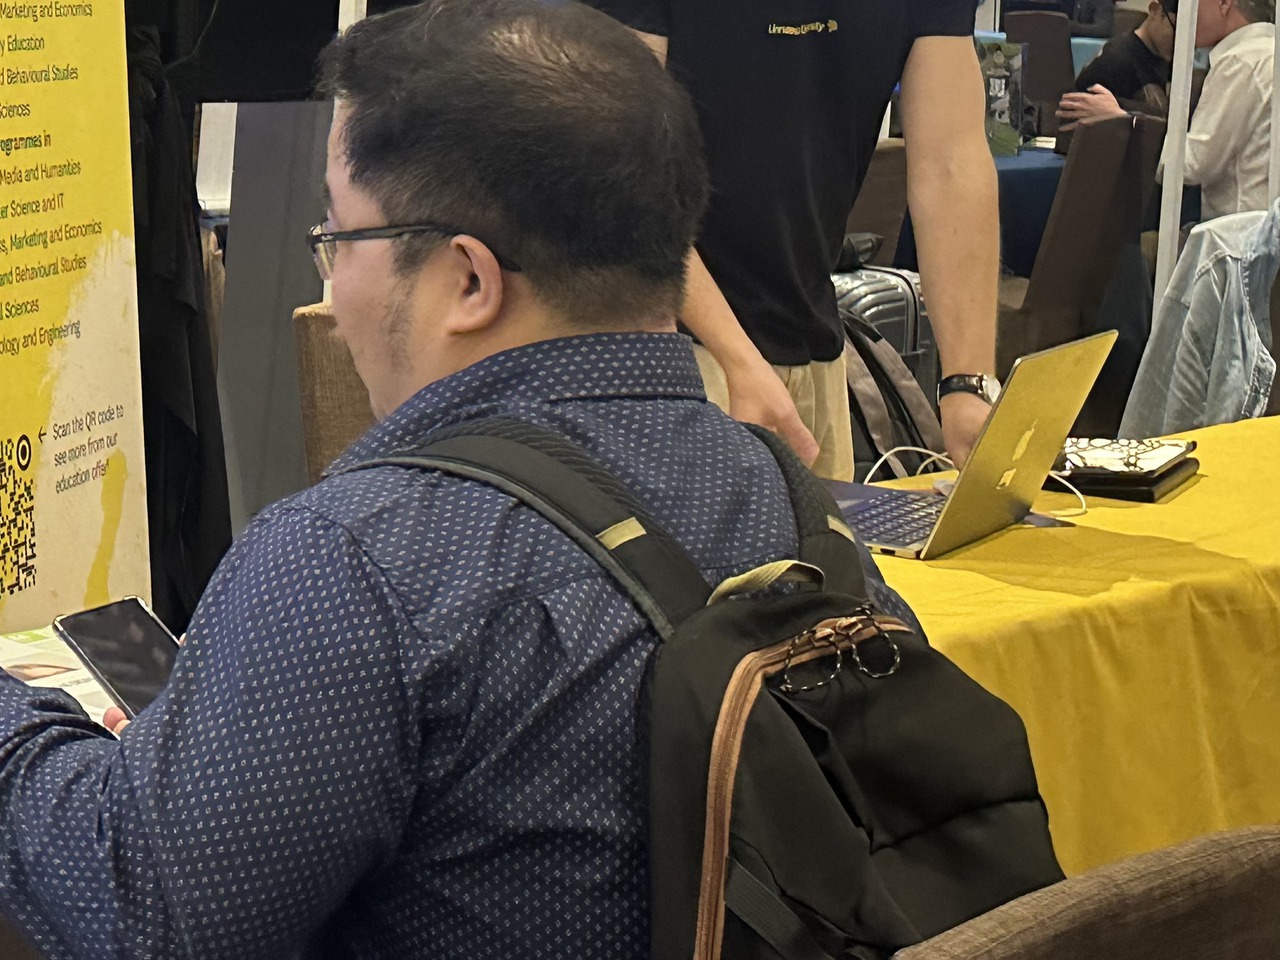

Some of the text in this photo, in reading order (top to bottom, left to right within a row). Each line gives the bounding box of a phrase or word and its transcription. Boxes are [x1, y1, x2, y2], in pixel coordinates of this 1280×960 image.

[0, 2, 38, 22] Marketing
[39, 3, 53, 18] and
[54, 1, 93, 17] Economics
[7, 34, 45, 52] Education
[6, 65, 50, 85] Behavioural
[52, 63, 79, 82] Studies
[43, 129, 51, 147] in
[0, 169, 23, 187] Media
[24, 164, 39, 182] and
[40, 159, 81, 180] Humanities
[10, 198, 40, 217] Science
[42, 195, 55, 211] and
[56, 193, 64, 209] IT
[10, 229, 48, 251] Marketing
[49, 225, 63, 240] and
[64, 219, 102, 239] Economics
[15, 257, 59, 284] Behavioural
[60, 253, 87, 274] Studies
[5, 298, 39, 319] Sciences
[22, 329, 37, 348] and
[39, 320, 81, 346] Engineering
[53, 404, 124, 440] Scan the QR code to
[54, 432, 118, 467] see more from our
[55, 468, 90, 494] education
